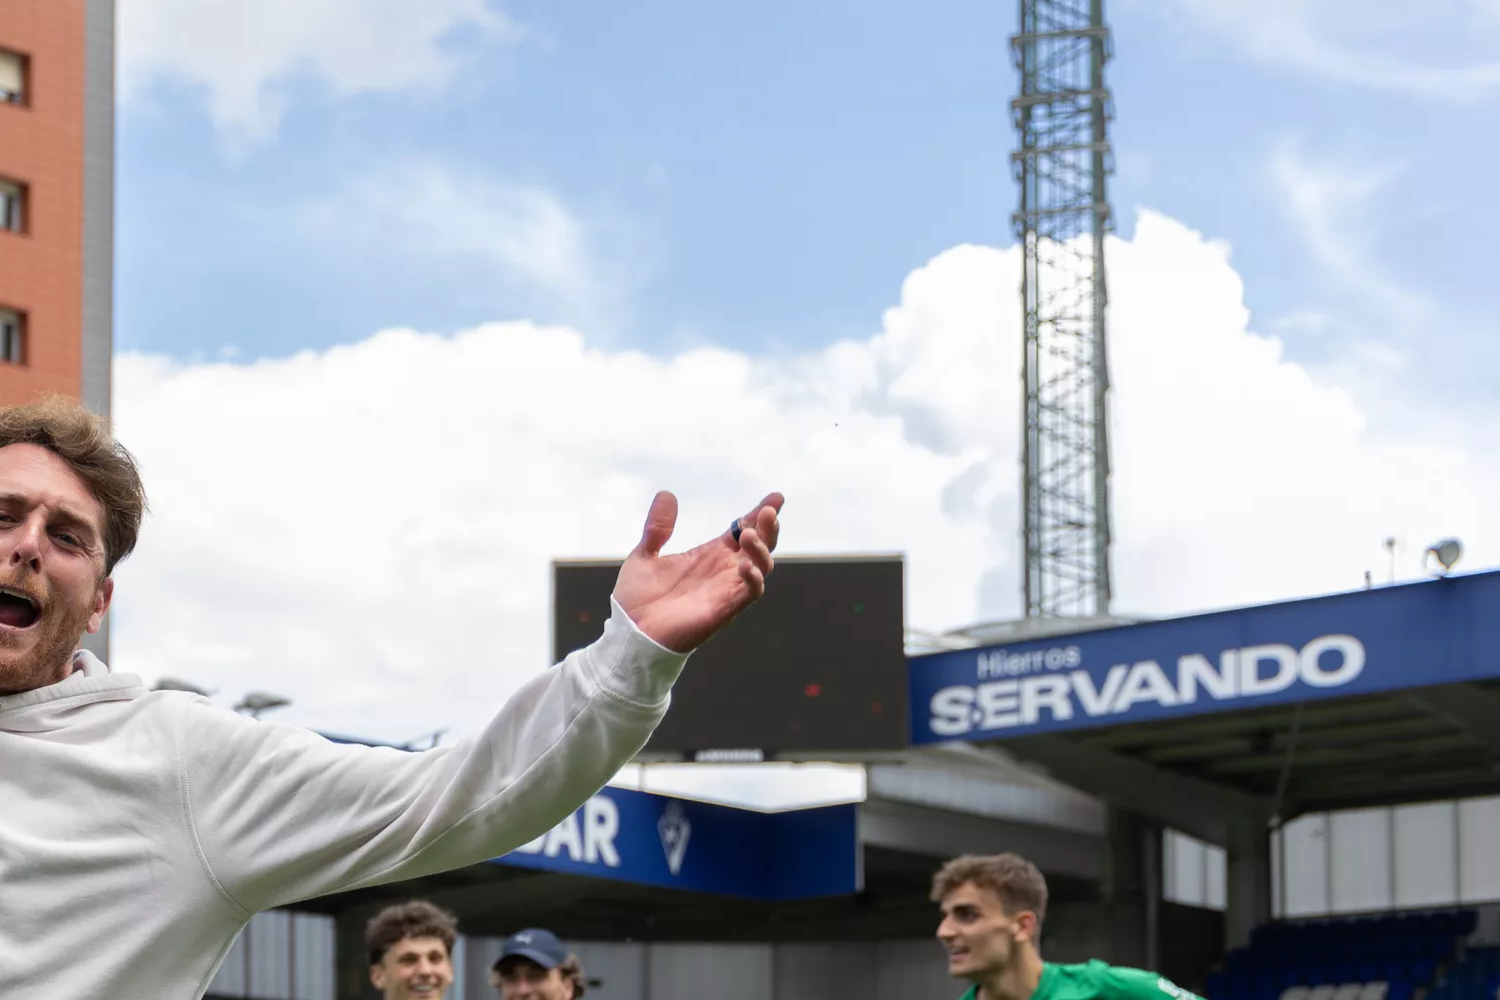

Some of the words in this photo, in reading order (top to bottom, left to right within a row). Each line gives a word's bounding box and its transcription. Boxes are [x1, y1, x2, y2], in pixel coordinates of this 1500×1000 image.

[930, 634, 1366, 735] SERVANDO
[977, 645, 1081, 679] Hierros
[514, 795, 621, 867] AR
